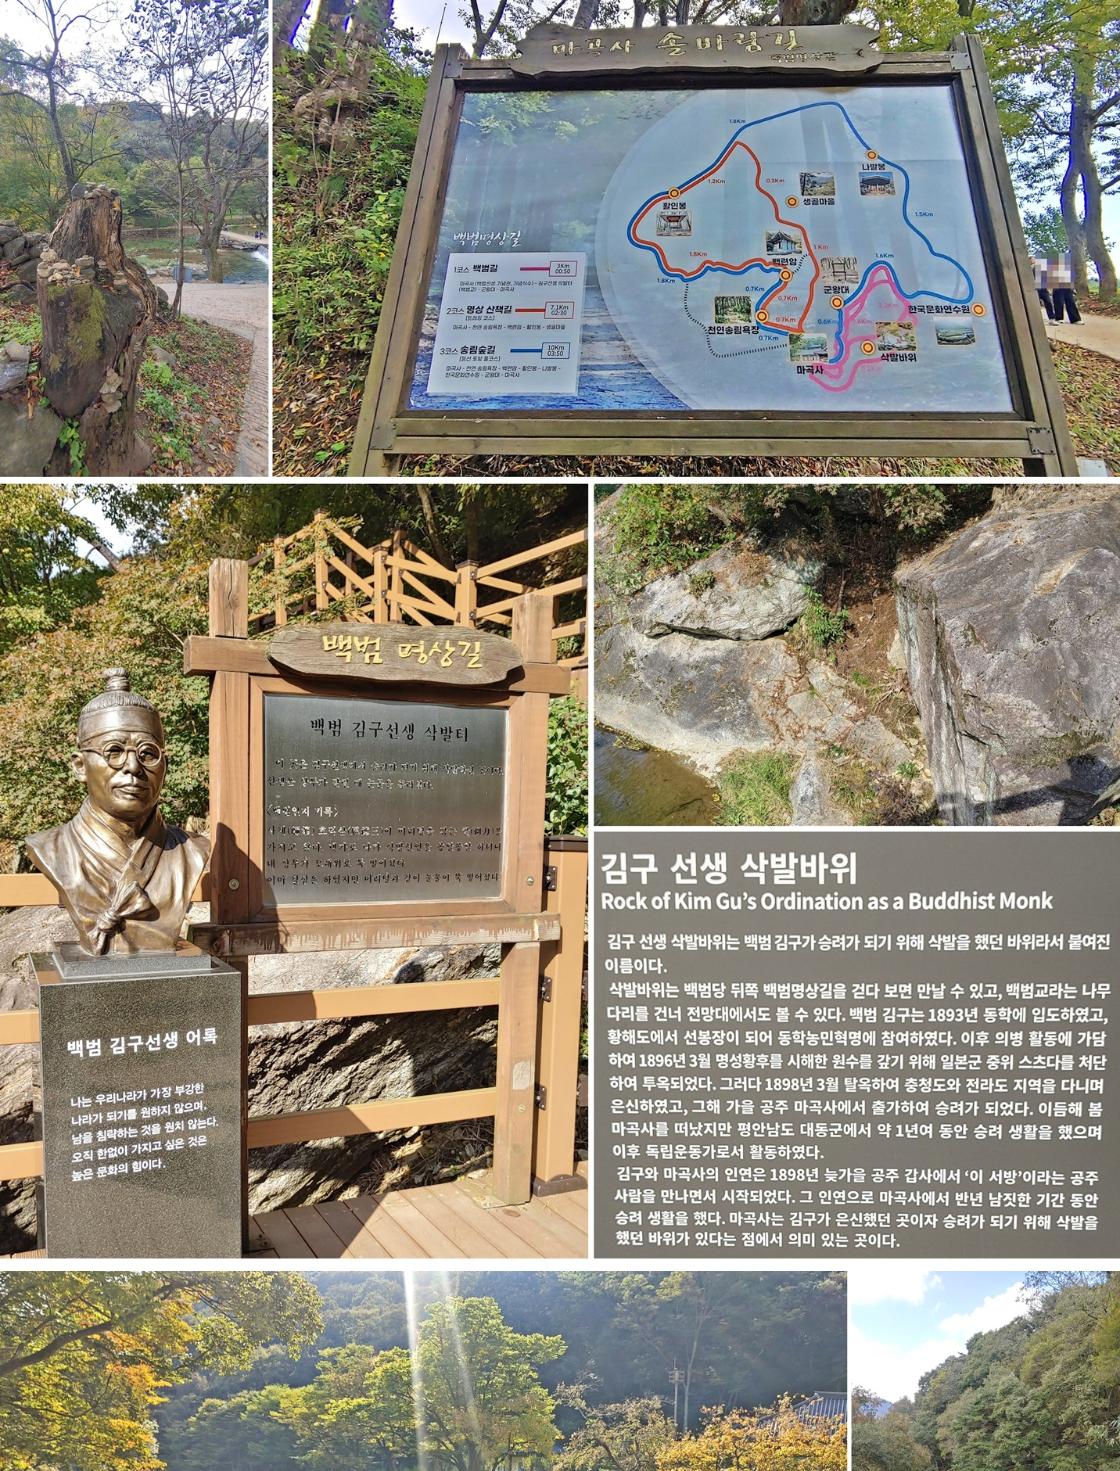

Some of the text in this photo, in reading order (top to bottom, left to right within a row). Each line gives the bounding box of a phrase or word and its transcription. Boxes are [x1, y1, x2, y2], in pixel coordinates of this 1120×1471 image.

[472, 264, 498, 273] 백범길
[824, 286, 850, 294] 군왕대
[466, 306, 484, 314] 명상
[486, 305, 513, 314] 산책길
[908, 305, 970, 314] 한국문화연수원
[708, 326, 760, 335] 천연송림욕장
[460, 345, 496, 355] 송림숲길
[881, 353, 917, 362] 삭발바위
[797, 365, 824, 374] 마곡사
[322, 634, 484, 668] 백범 명상길
[310, 718, 342, 738] 백범
[352, 720, 416, 742] 김구선생
[601, 852, 856, 884] 김구 선생 삭발바위
[601, 891, 1053, 910] Rock of Kim Gu’s Ordination as a Buddhist Monk
[608, 934, 1110, 951] 김구 선생 삭발바위는 백범 김구가 승려가 되기 위해 삭발을 했던 바위라서 붙여진
[605, 958, 667, 974] 이름이다.
[610, 982, 1111, 1000] 삭발바위는 백범당 뒤쪽 백범명상길을 걷다 보면 만날 수 있고, 백범교라는 나무
[607, 1006, 1108, 1024] 다리를 건너 전망대에서도 볼 수 있다. 백범 김구는 1893년 동학에 입도하였고,
[67, 1028, 218, 1057] 백범 김구선생 어록
[608, 1029, 1106, 1047] 황해도에서 선봉장이 되어 동학농민혁명에 참여하였다. 이후 의병 활동에 가담
[608, 1053, 1107, 1070] 하여 1896년 3월 명성황후를 시해한 원수를 갚기 위해 일본군 중위 스츠다를 처단
[609, 1076, 1103, 1094] 하여 투옥되었다. 그러다 1898년 3월 탈옥하여 충청도와 전라도 지역을 다니며
[71, 1082, 204, 1108] 나는 우리나라가 가장 부강한
[71, 1112, 103, 1126] 나라가
[106, 1108, 137, 1122] 되기를
[140, 1104, 171, 1118] 원하지
[72, 1116, 219, 1145] 남을 침략하는 것을 원치 않는다.
[72, 1135, 207, 1163] 오직 한없이 가지고 싶은 것은
[72, 1158, 166, 1181] 높은 문화의 힘이다.
[616, 1231, 900, 1248] 했던 바위가 있다는 점에서 의미 있는 곳이다.
